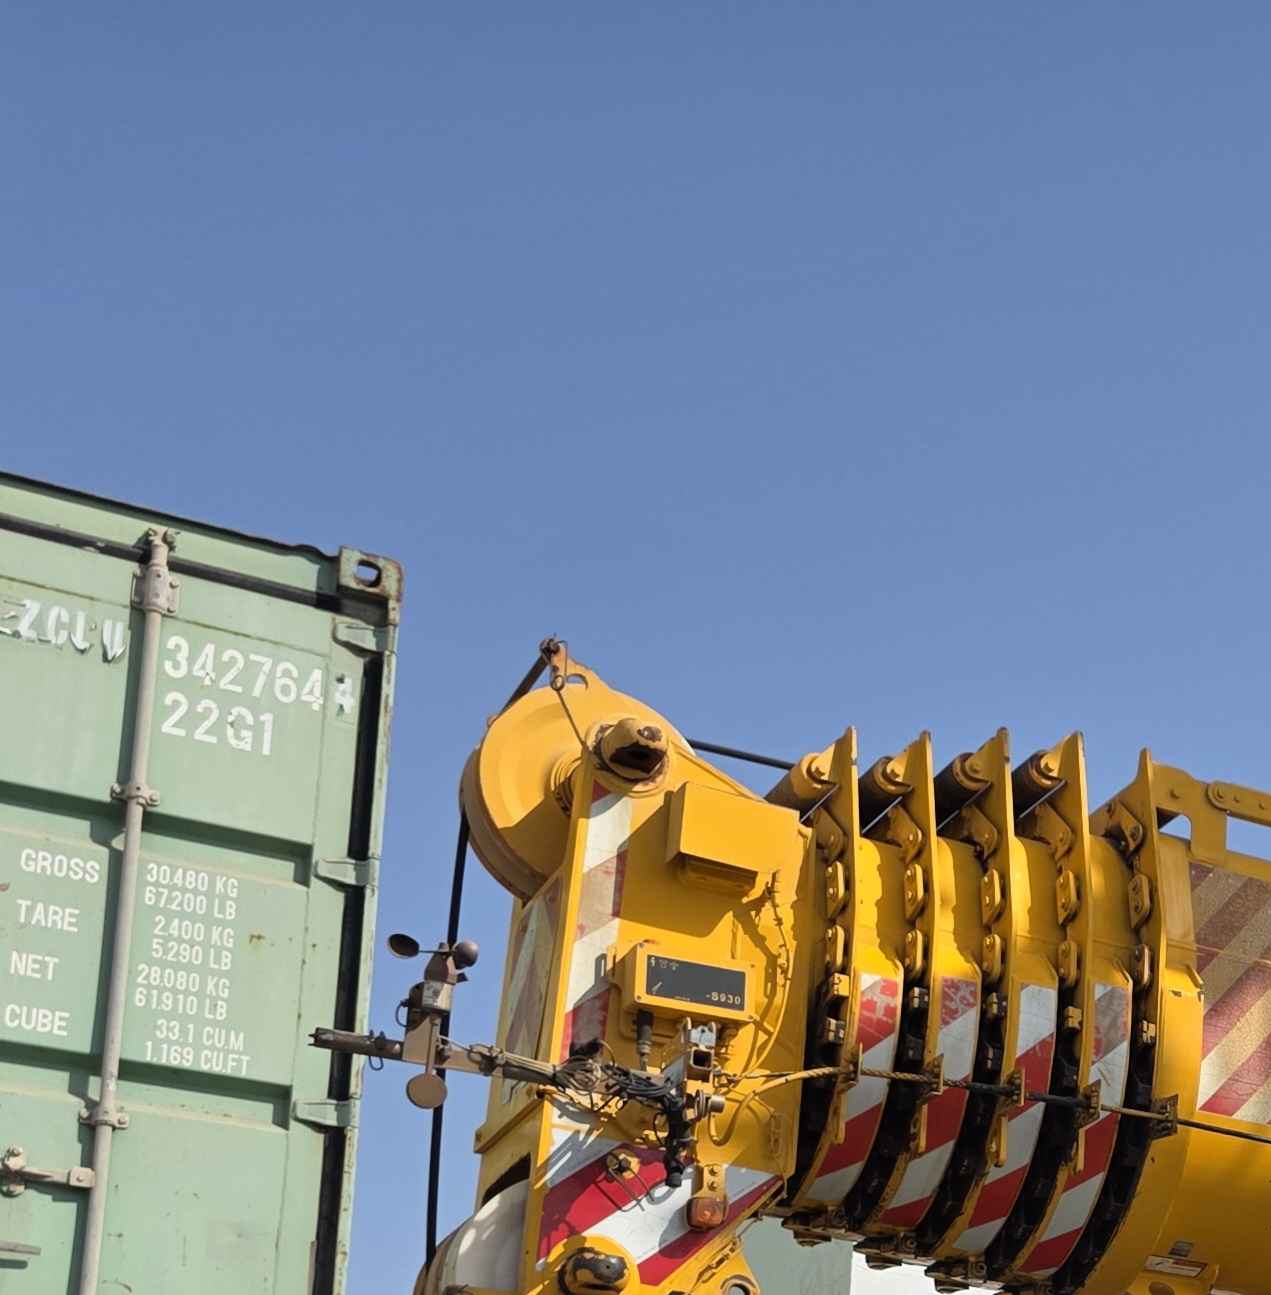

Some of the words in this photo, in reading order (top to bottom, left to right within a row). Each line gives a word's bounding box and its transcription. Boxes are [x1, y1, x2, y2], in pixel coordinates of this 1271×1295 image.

[163, 635, 324, 711] 342764
[161, 691, 274, 757] 22G1
[20, 848, 100, 883] GROSS
[146, 863, 208, 892] 30.480
[215, 875, 239, 898] KG
[16, 899, 80, 932] TARE
[153, 915, 205, 941] 2.400
[211, 926, 235, 948] KG
[144, 886, 207, 915] 67.200
[213, 898, 236, 920] LB
[9, 950, 59, 981] NET
[136, 963, 200, 992] 28.080
[206, 975, 231, 998] KG
[151, 939, 203, 965] 5.290
[209, 948, 232, 970] LB
[135, 987, 198, 1015] 61.910
[204, 998, 227, 1020] LB
[4, 1004, 71, 1037] CUBE
[155, 1018, 195, 1043] 33.1
[202, 1026, 245, 1051] CU.M
[144, 1041, 194, 1067] 1.169
[200, 1049, 251, 1076] CU.FT
